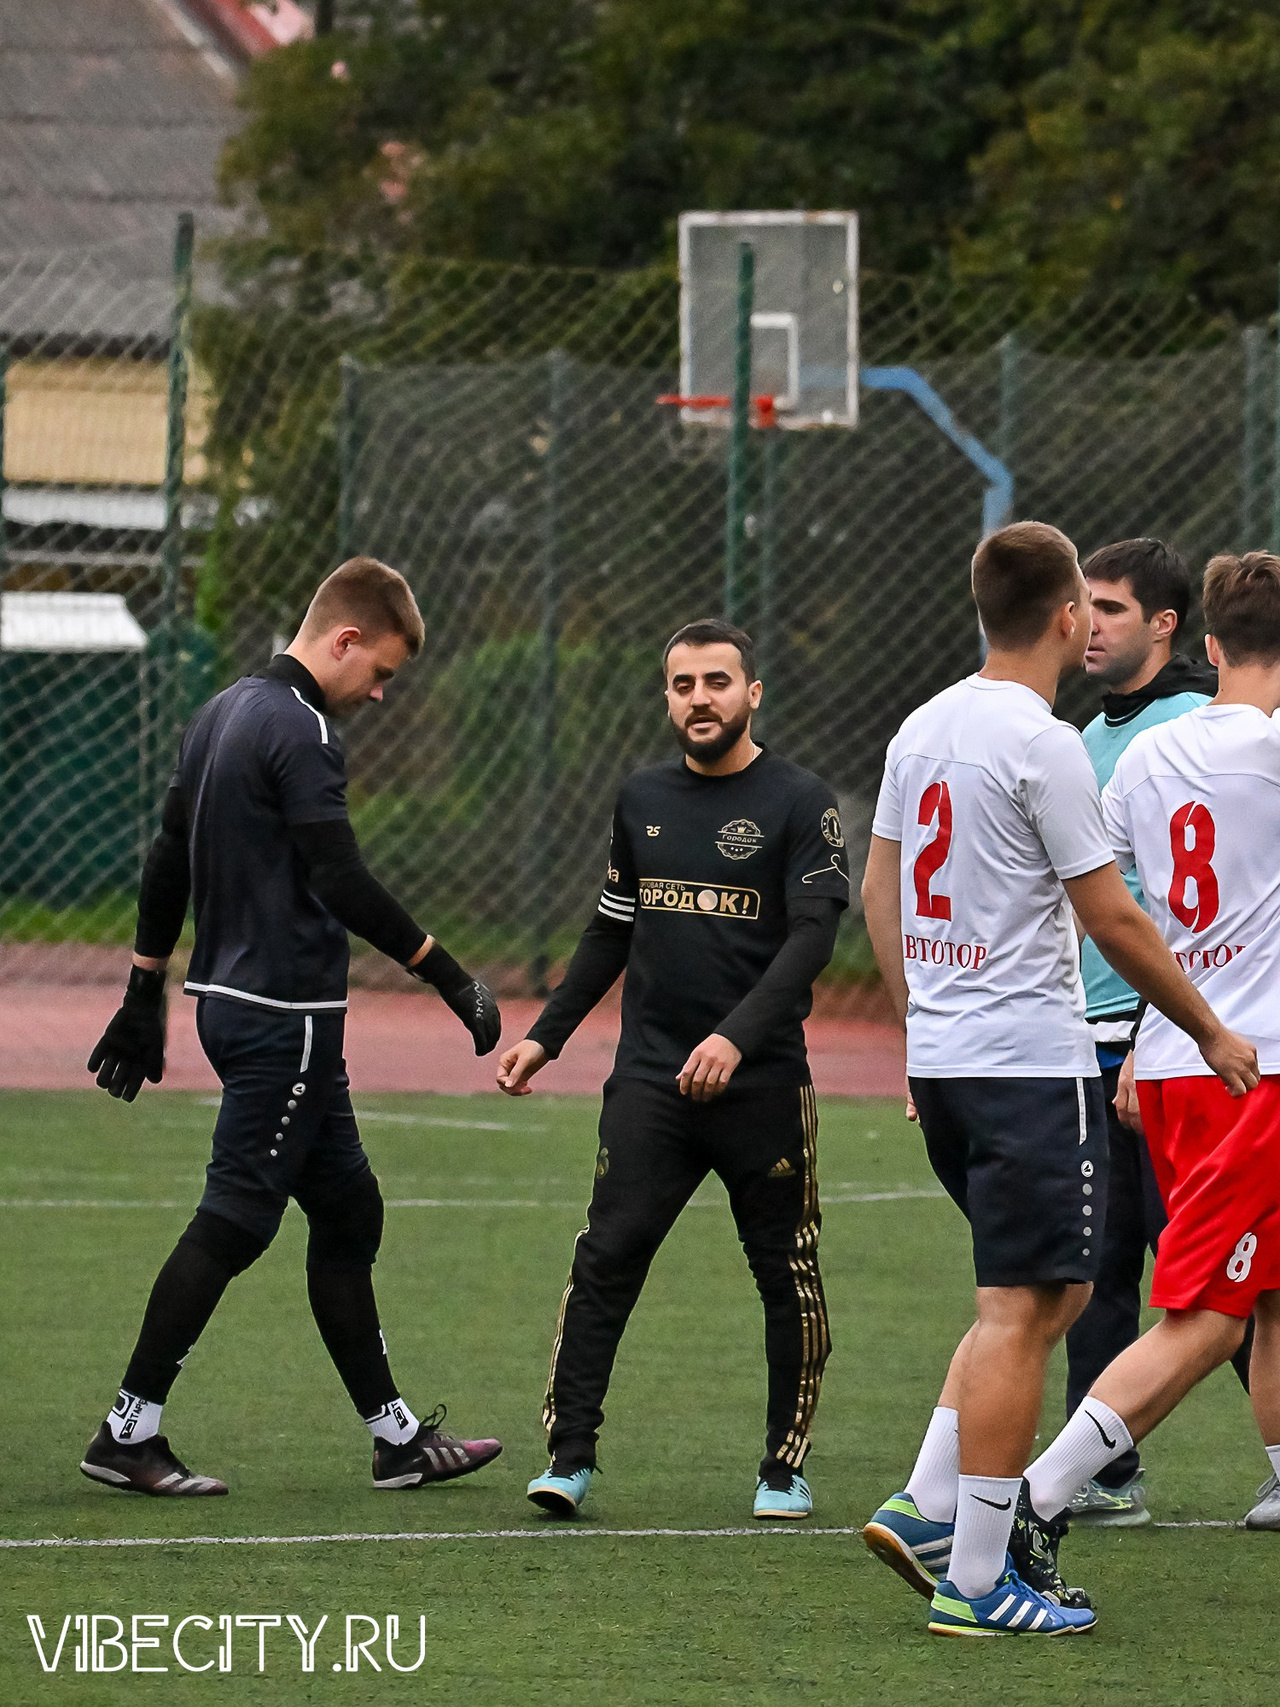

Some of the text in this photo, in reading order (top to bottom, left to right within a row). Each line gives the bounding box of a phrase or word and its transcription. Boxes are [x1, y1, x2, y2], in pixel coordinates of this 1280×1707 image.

[665, 882, 686, 891] СЕТЬ
[914, 780, 953, 921] 2
[1168, 801, 1220, 933] 8
[1226, 1232, 1258, 1283] 8
